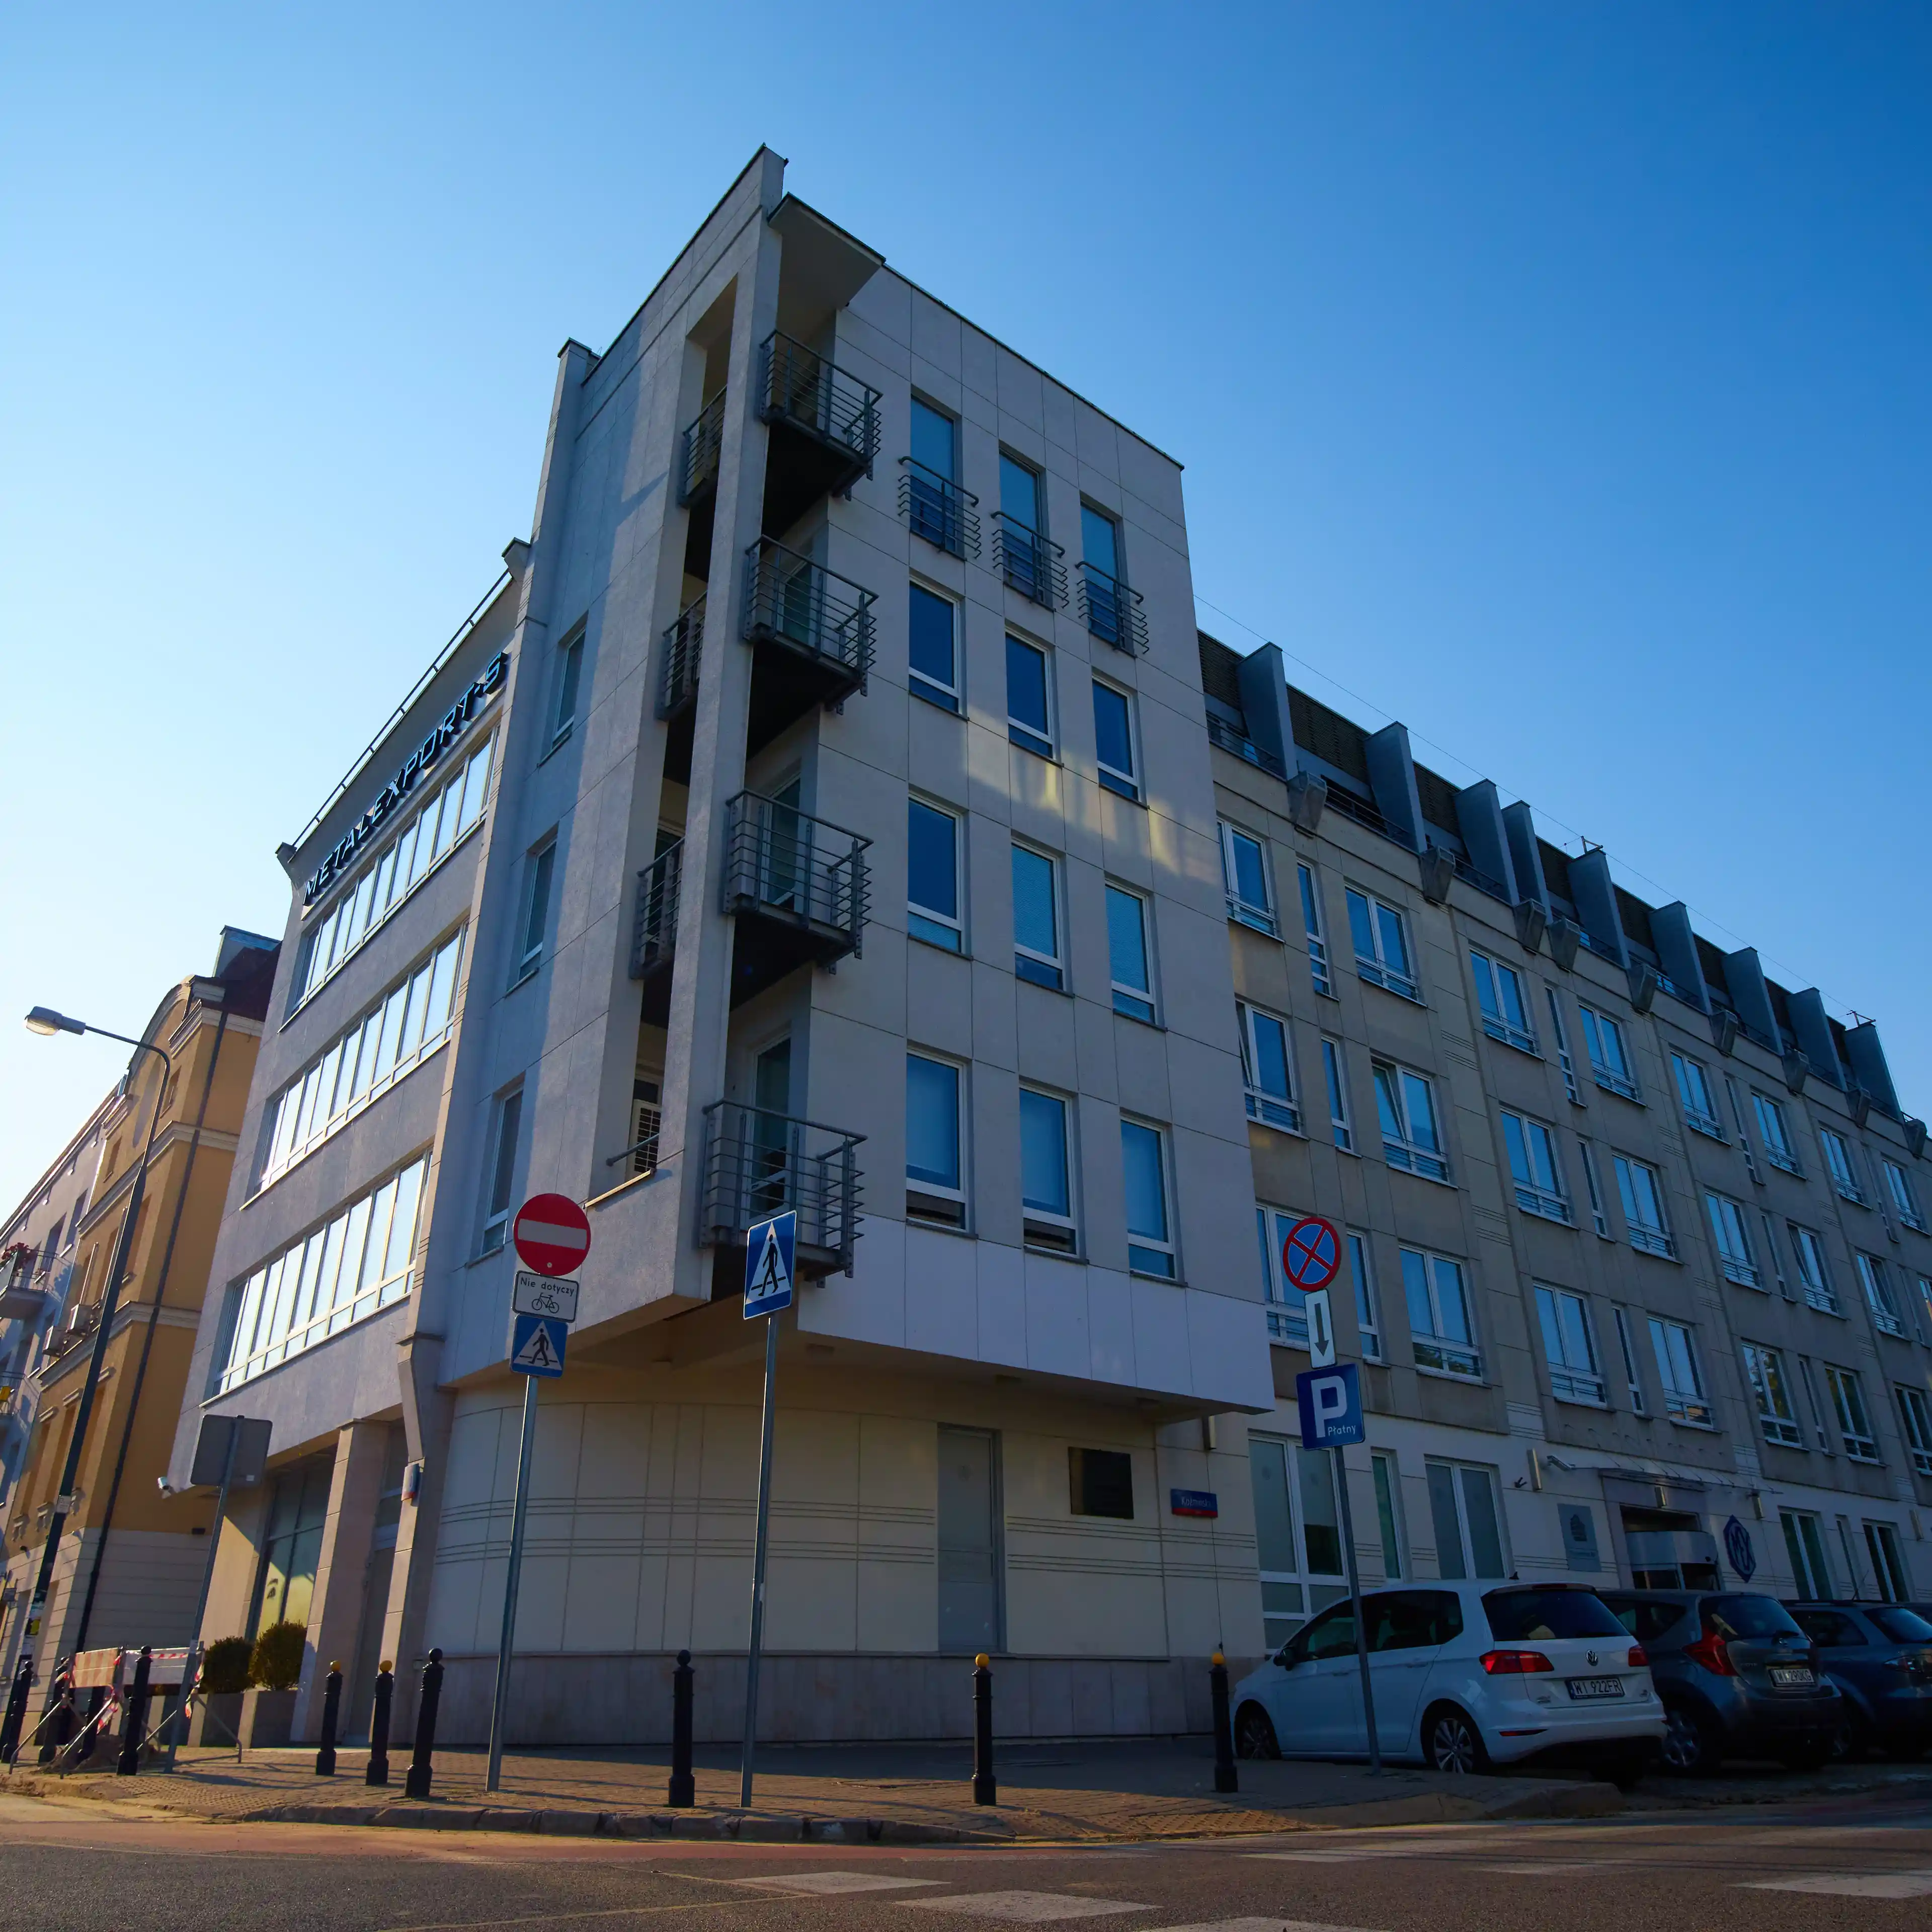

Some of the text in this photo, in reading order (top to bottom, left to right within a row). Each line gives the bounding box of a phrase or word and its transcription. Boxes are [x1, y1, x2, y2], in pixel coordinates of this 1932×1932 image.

[520, 1276, 574, 1297] Nie dotyczy
[1311, 1375, 1347, 1438] P
[1328, 1424, 1356, 1436] Płatny
[1573, 1681, 1588, 1694] WI
